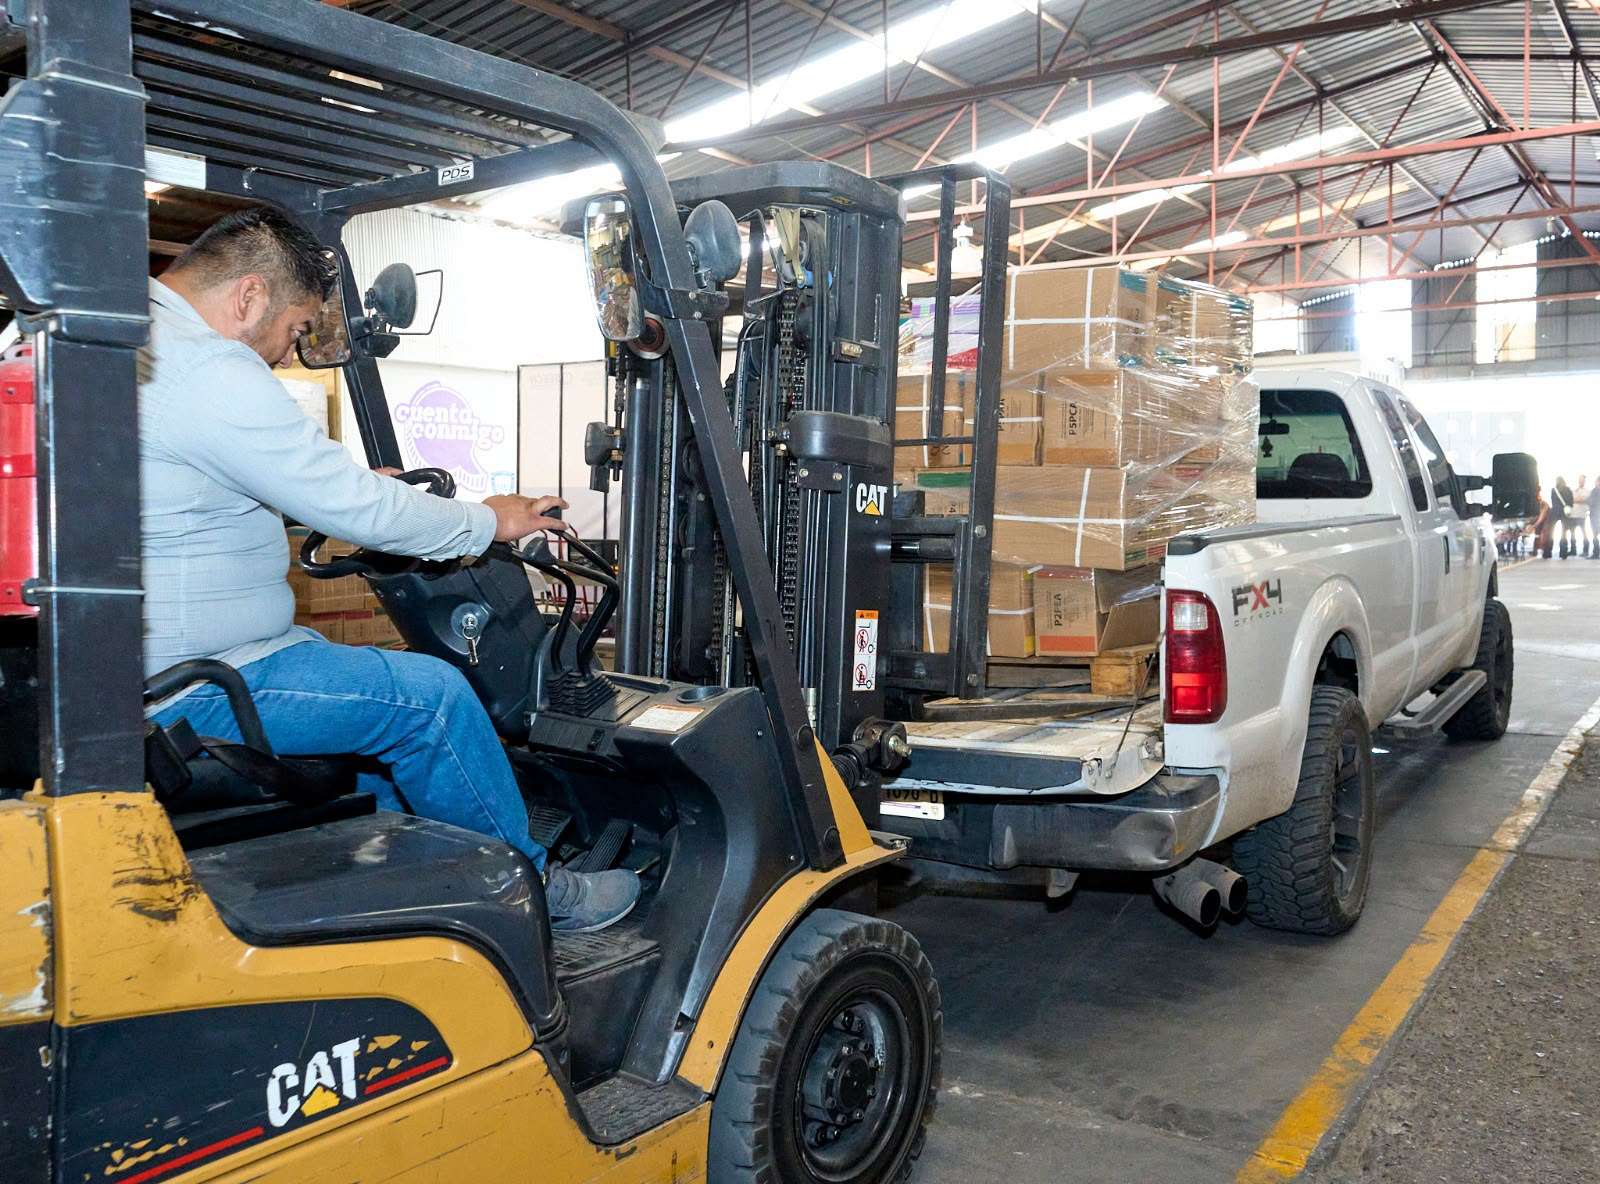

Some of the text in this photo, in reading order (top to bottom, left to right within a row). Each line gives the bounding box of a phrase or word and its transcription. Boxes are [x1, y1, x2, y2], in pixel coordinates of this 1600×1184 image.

[441, 165, 471, 181] PDS
[411, 418, 504, 451] conmigo
[1068, 401, 1078, 436] P5PCA
[855, 482, 888, 516] CAT
[1231, 578, 1282, 616] FX4
[266, 1036, 361, 1128] CAT
